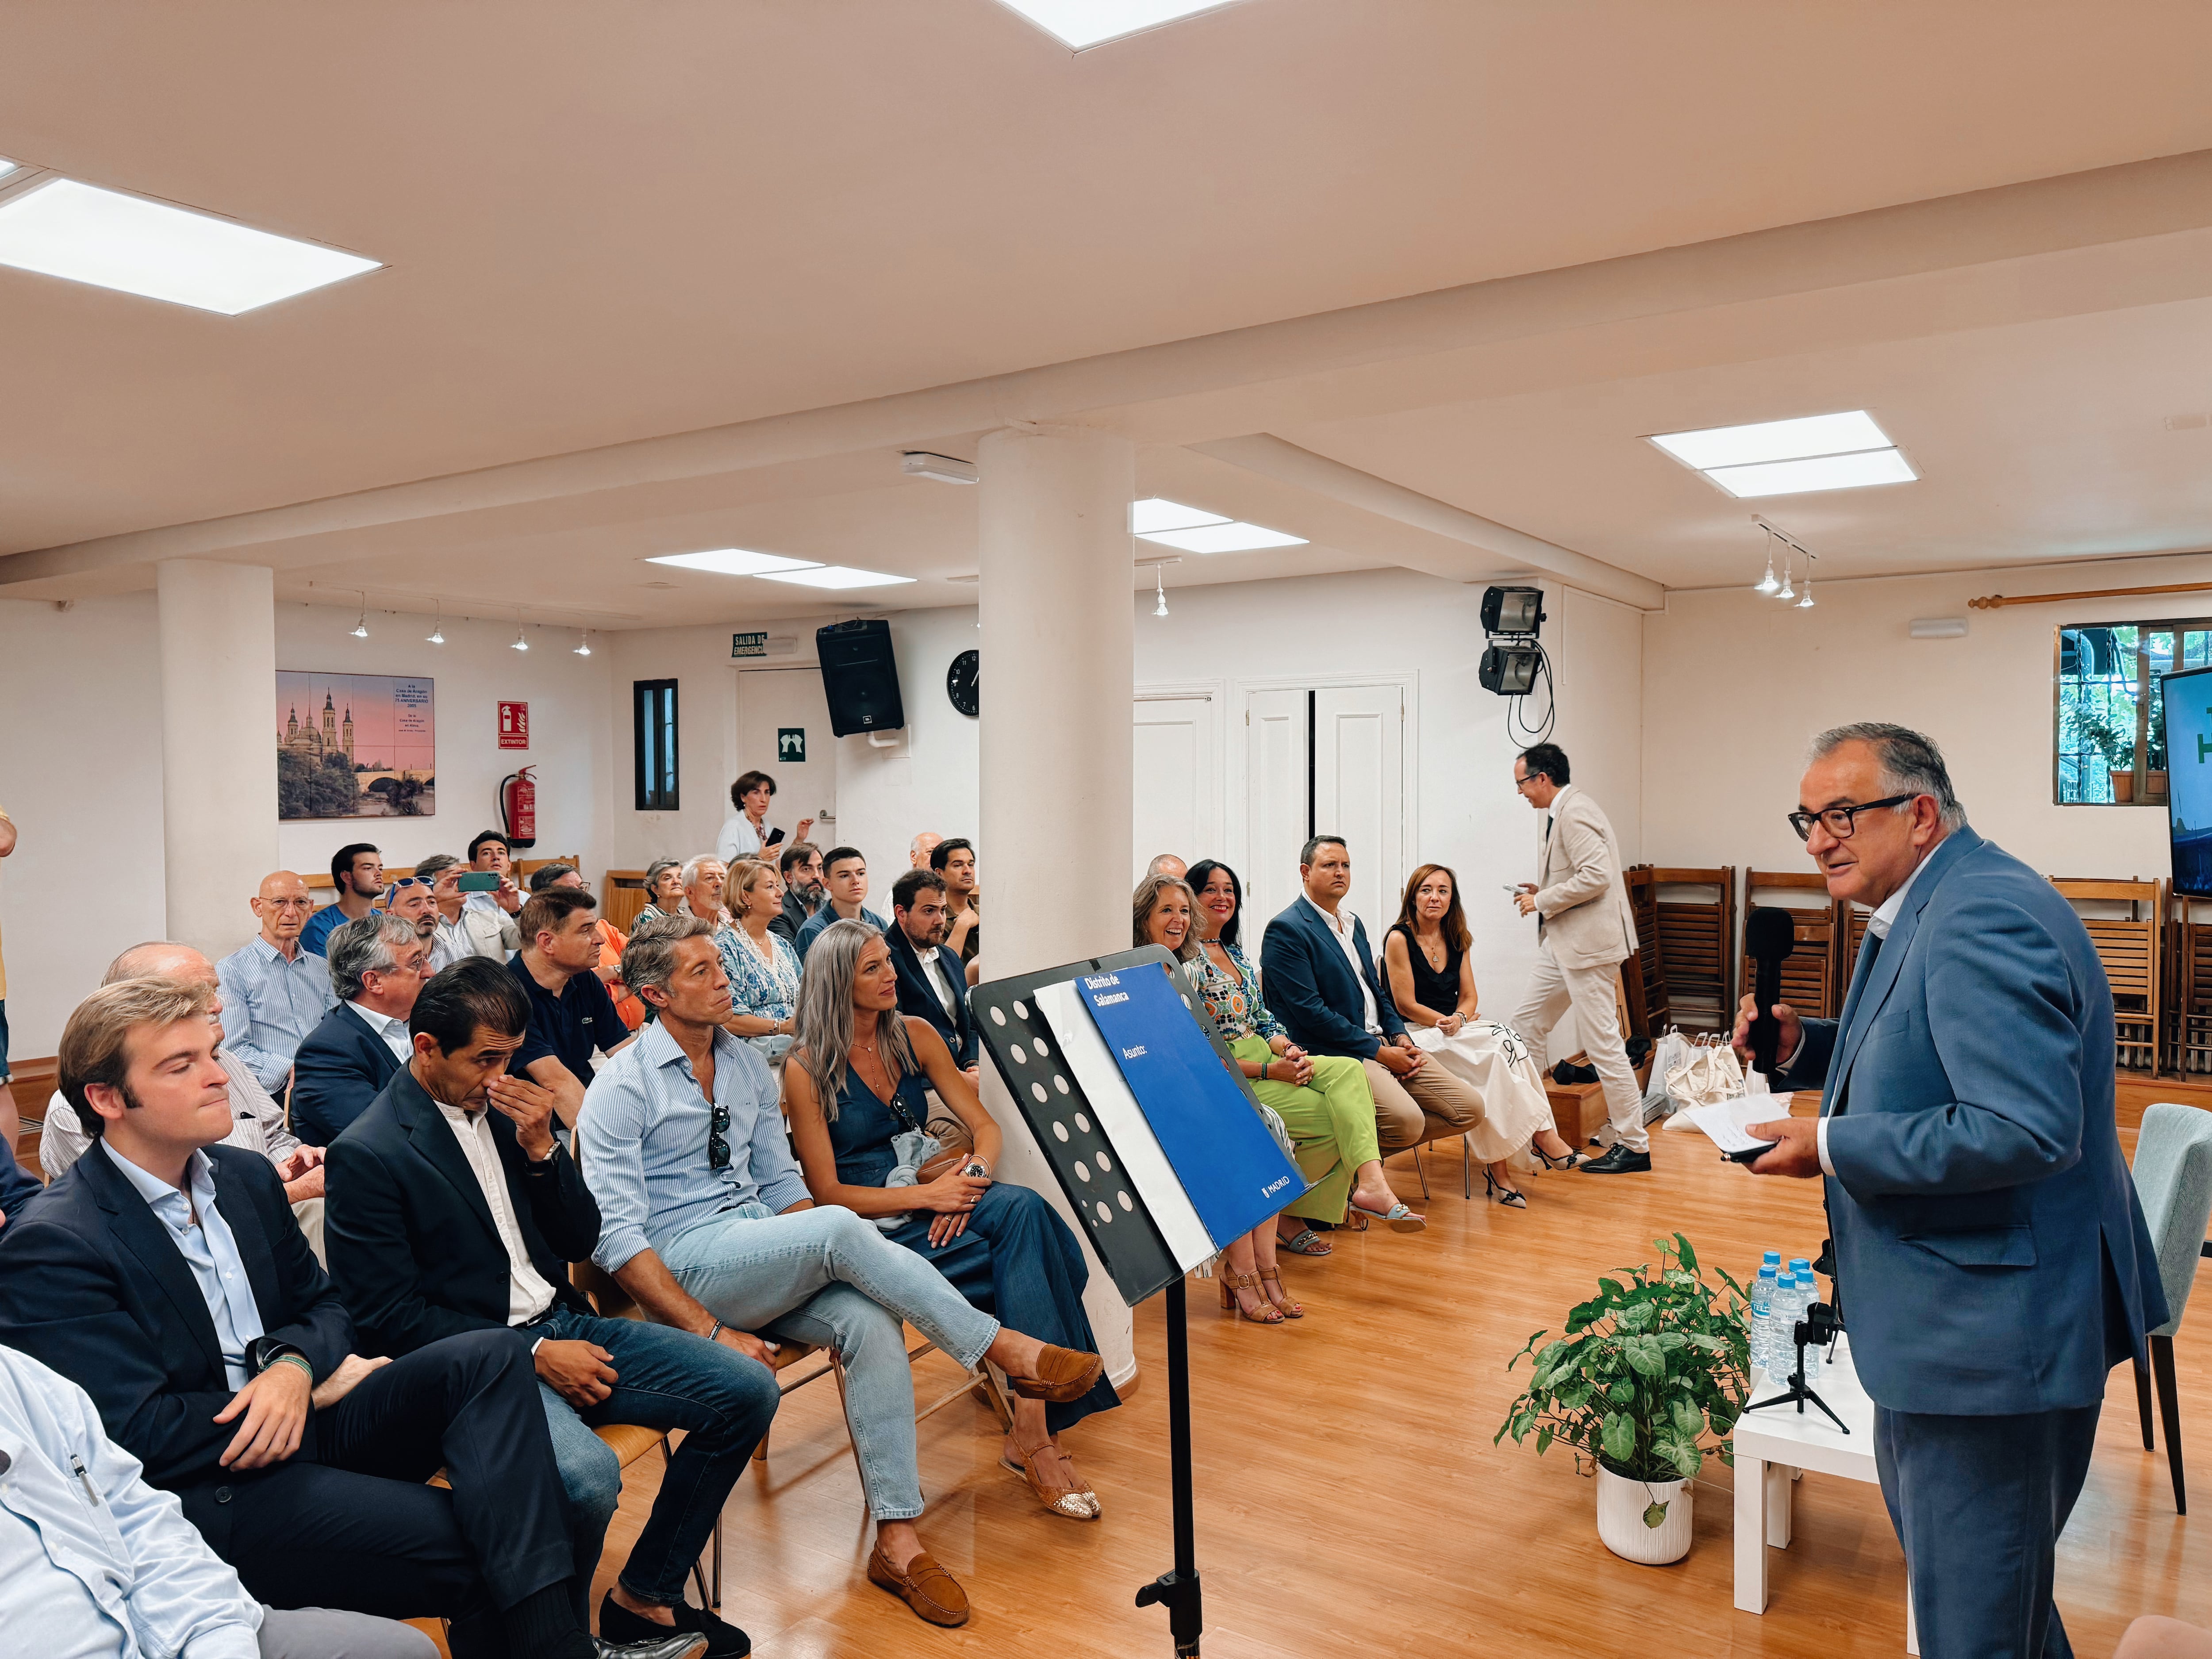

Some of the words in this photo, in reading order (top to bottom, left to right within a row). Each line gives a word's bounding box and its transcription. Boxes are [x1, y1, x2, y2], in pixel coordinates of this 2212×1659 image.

[735, 635, 755, 645] SALIDA
[757, 634, 765, 644] DE
[1084, 975, 1111, 990] Distrito
[1109, 973, 1120, 985] de
[1093, 992, 1129, 1007] Salamanca
[1122, 1045, 1148, 1060] Asunto:
[1267, 1176, 1290, 1194] MADRID
